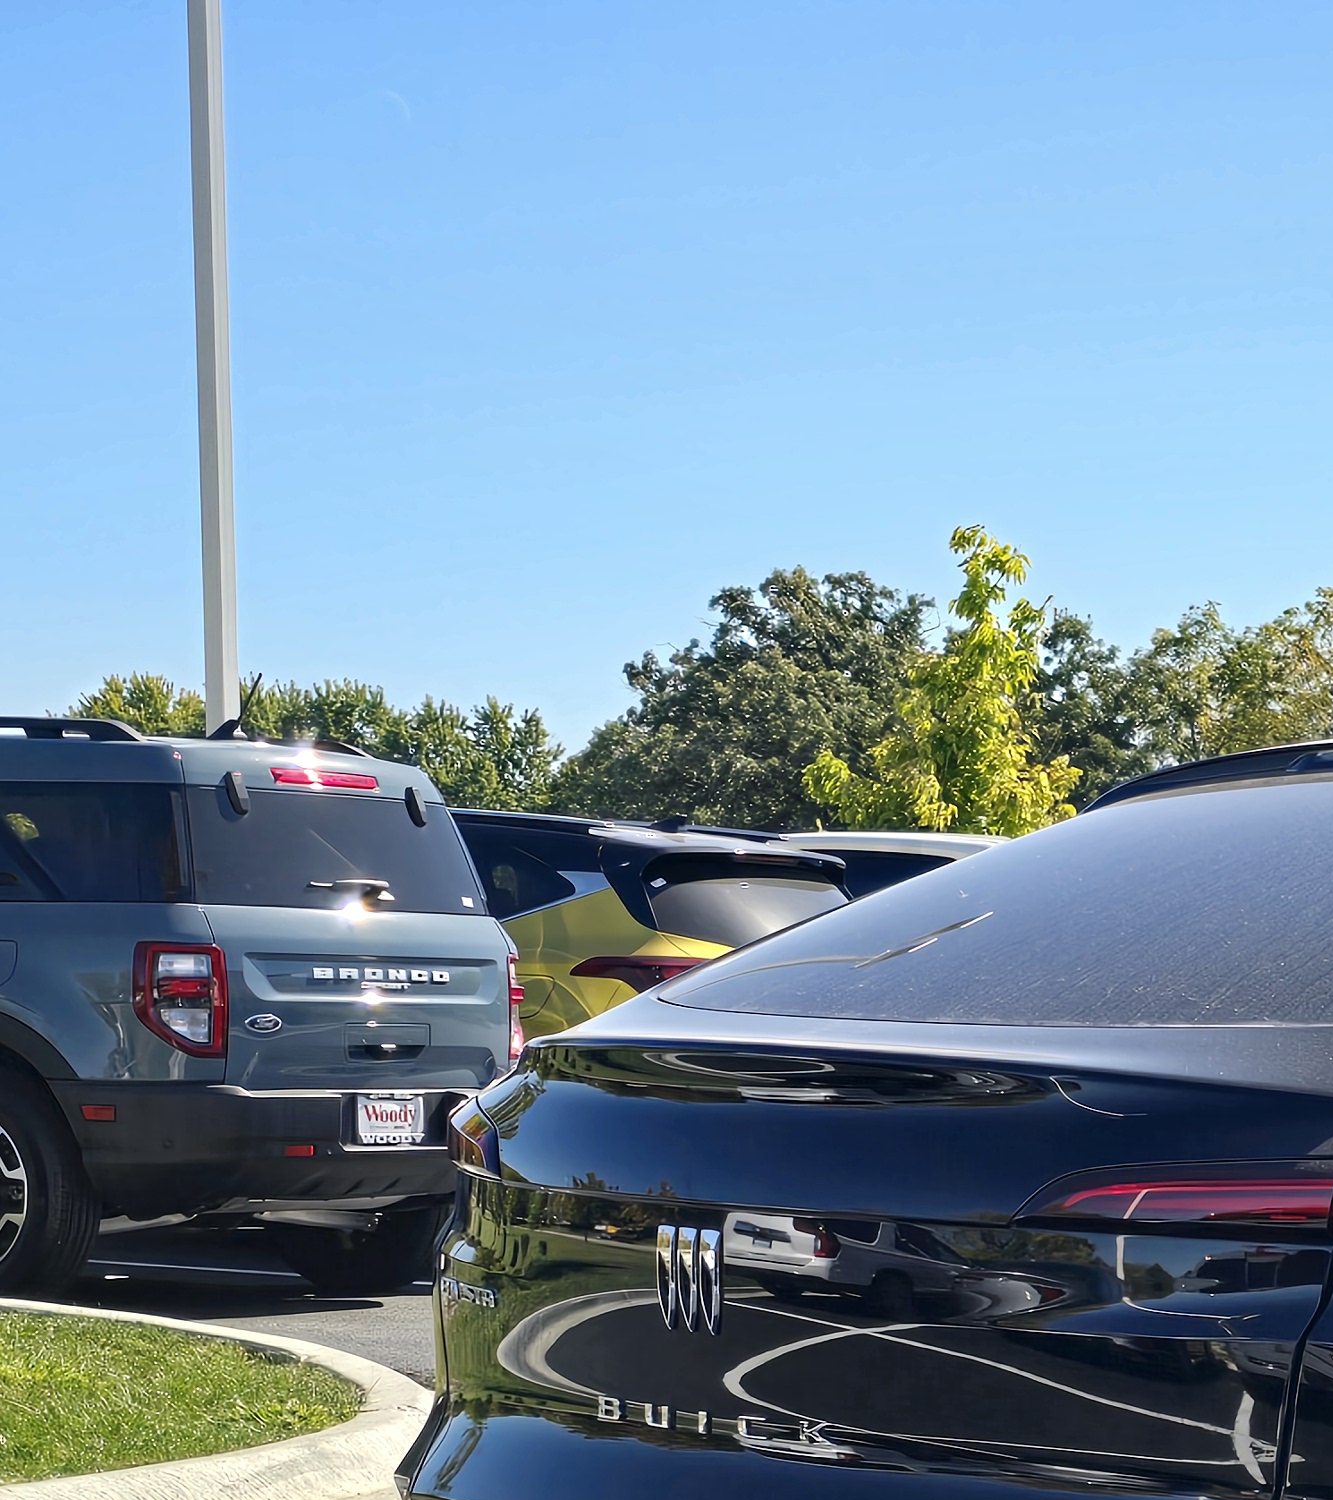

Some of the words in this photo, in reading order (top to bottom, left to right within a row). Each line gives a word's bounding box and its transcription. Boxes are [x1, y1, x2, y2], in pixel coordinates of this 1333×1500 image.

[312, 967, 450, 983] BRONCO
[364, 1104, 416, 1127] Woody
[360, 1132, 426, 1144] WOODY
[598, 1396, 836, 1445] BUICK
